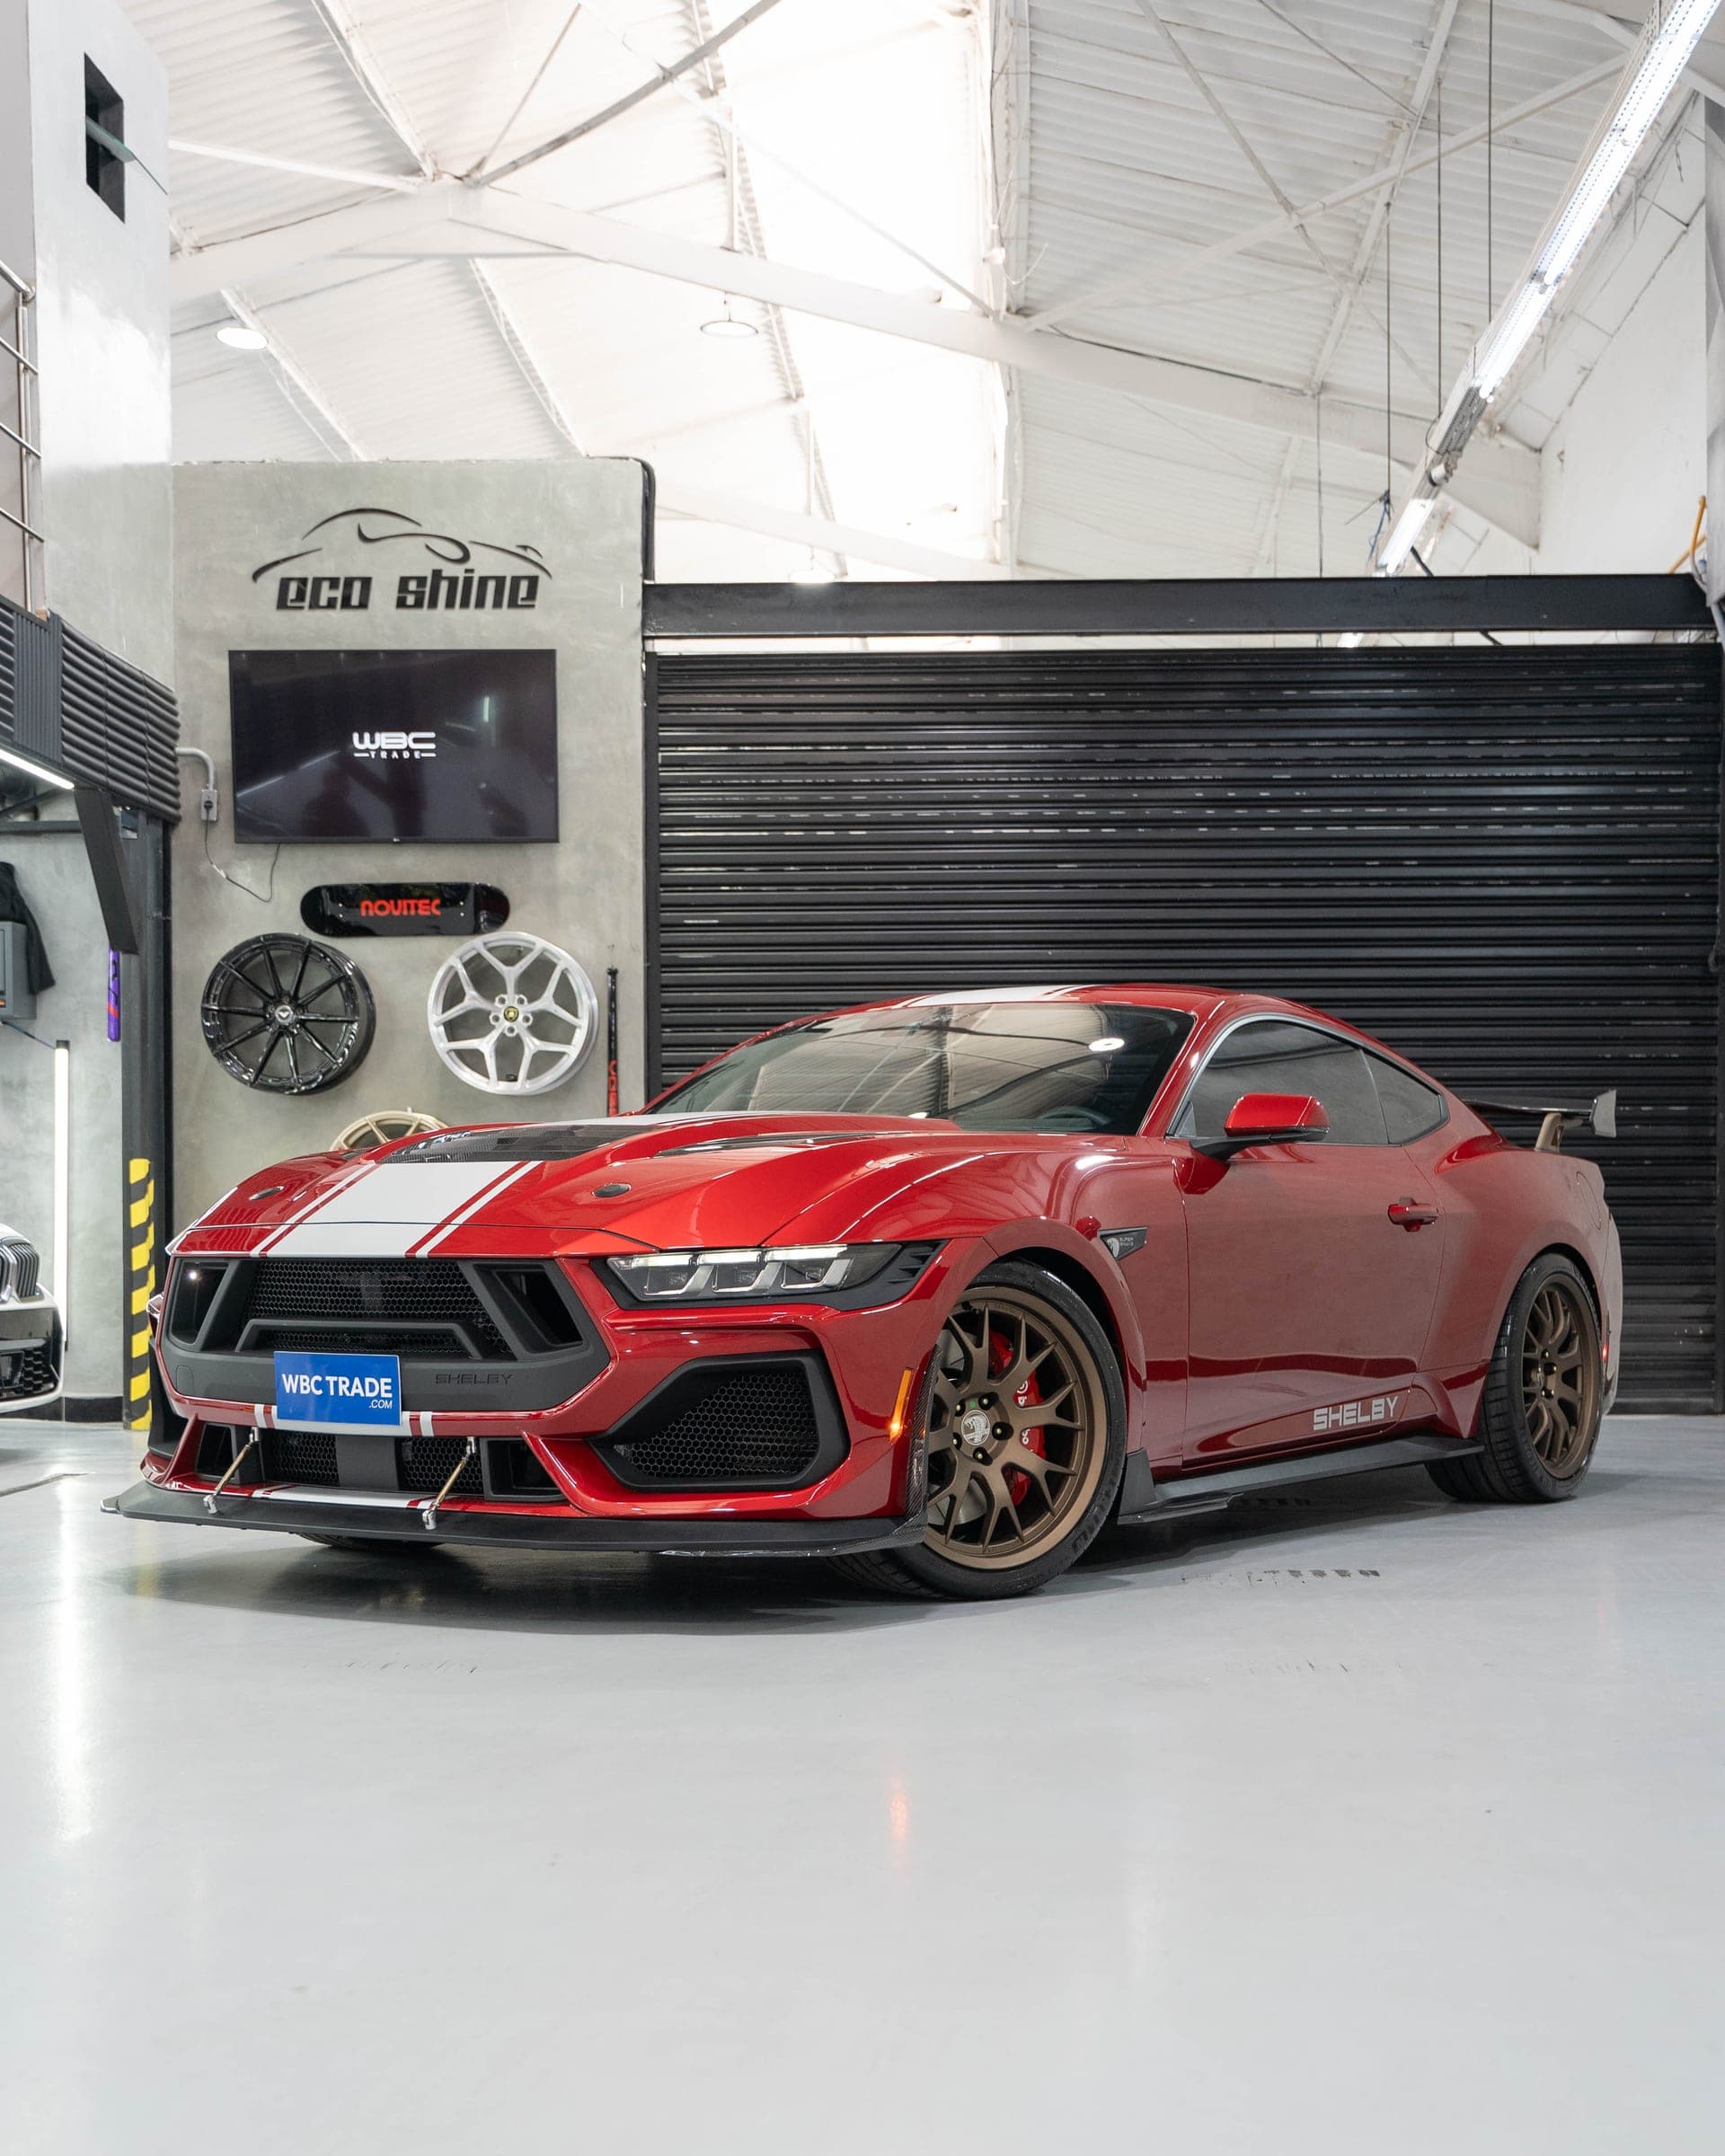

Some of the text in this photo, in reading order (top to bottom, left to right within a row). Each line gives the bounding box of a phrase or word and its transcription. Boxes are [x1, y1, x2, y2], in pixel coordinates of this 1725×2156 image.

[277, 569, 540, 611] eco shine
[352, 731, 436, 750] WBC
[360, 898, 440, 917] NOVITEC
[281, 1373, 393, 1399] WBC TRADE
[435, 1373, 514, 1385] SHELBY
[368, 1399, 393, 1409] .COM
[1313, 1395, 1399, 1431] SHELBY
